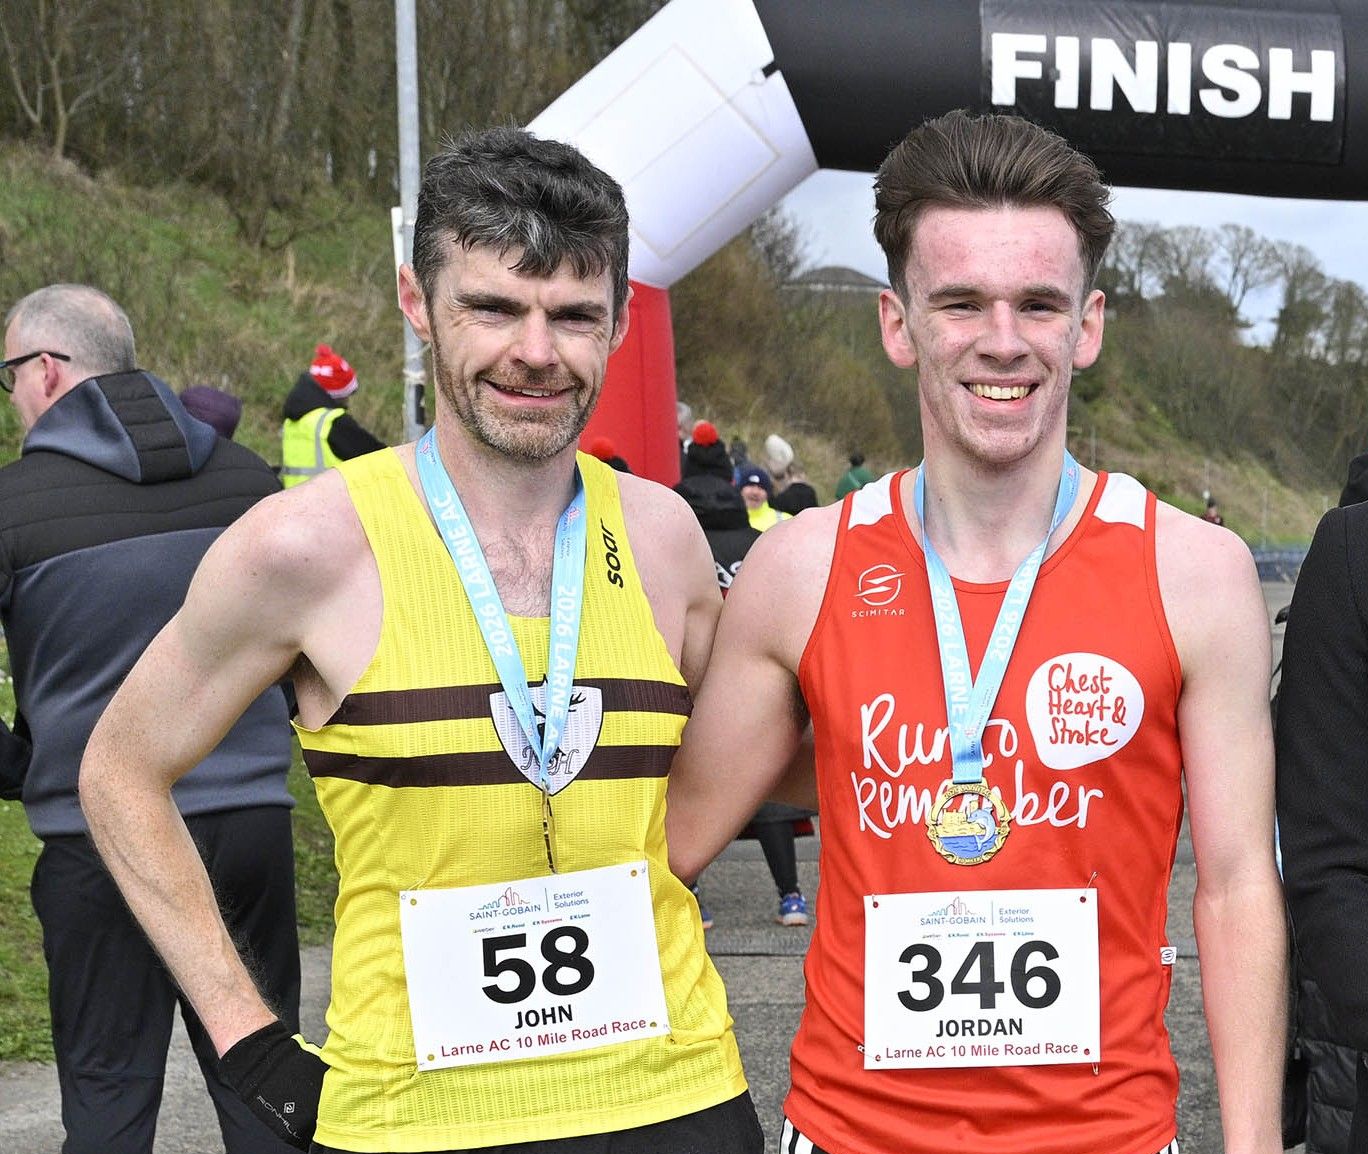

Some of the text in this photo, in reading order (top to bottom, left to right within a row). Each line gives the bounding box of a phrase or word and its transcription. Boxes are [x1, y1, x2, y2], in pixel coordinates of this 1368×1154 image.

[991, 32, 1335, 122] FINISH
[601, 517, 624, 589] soar
[433, 491, 513, 657] 2026 LARNE AC
[555, 585, 576, 640] 2026
[851, 608, 905, 618] SCIMITAR
[990, 611, 1018, 661] 2026
[551, 643, 571, 720] LARNE
[943, 640, 969, 715] LARNE
[1048, 663, 1112, 693] Chest
[1048, 689, 1126, 726] Heart &
[1050, 717, 1118, 747] Stroke
[553, 890, 584, 901] Exterior
[554, 898, 589, 909] Solutions
[999, 907, 1030, 916] Exterior
[469, 904, 541, 921] SAINT-GOBAIN
[920, 916, 986, 926] SAINT-GOBAIN
[999, 915, 1034, 924] Solutions
[482, 925, 595, 1005] 58
[897, 940, 1061, 1012] 346
[514, 1004, 573, 1029] JOHN
[936, 1018, 1023, 1037] JORDAN
[441, 1018, 646, 1057] Larne AC 10 Mile Road Race
[886, 1042, 1078, 1059] Larne AC 10 Mile Road Race
[256, 1095, 301, 1139] RONHILL
